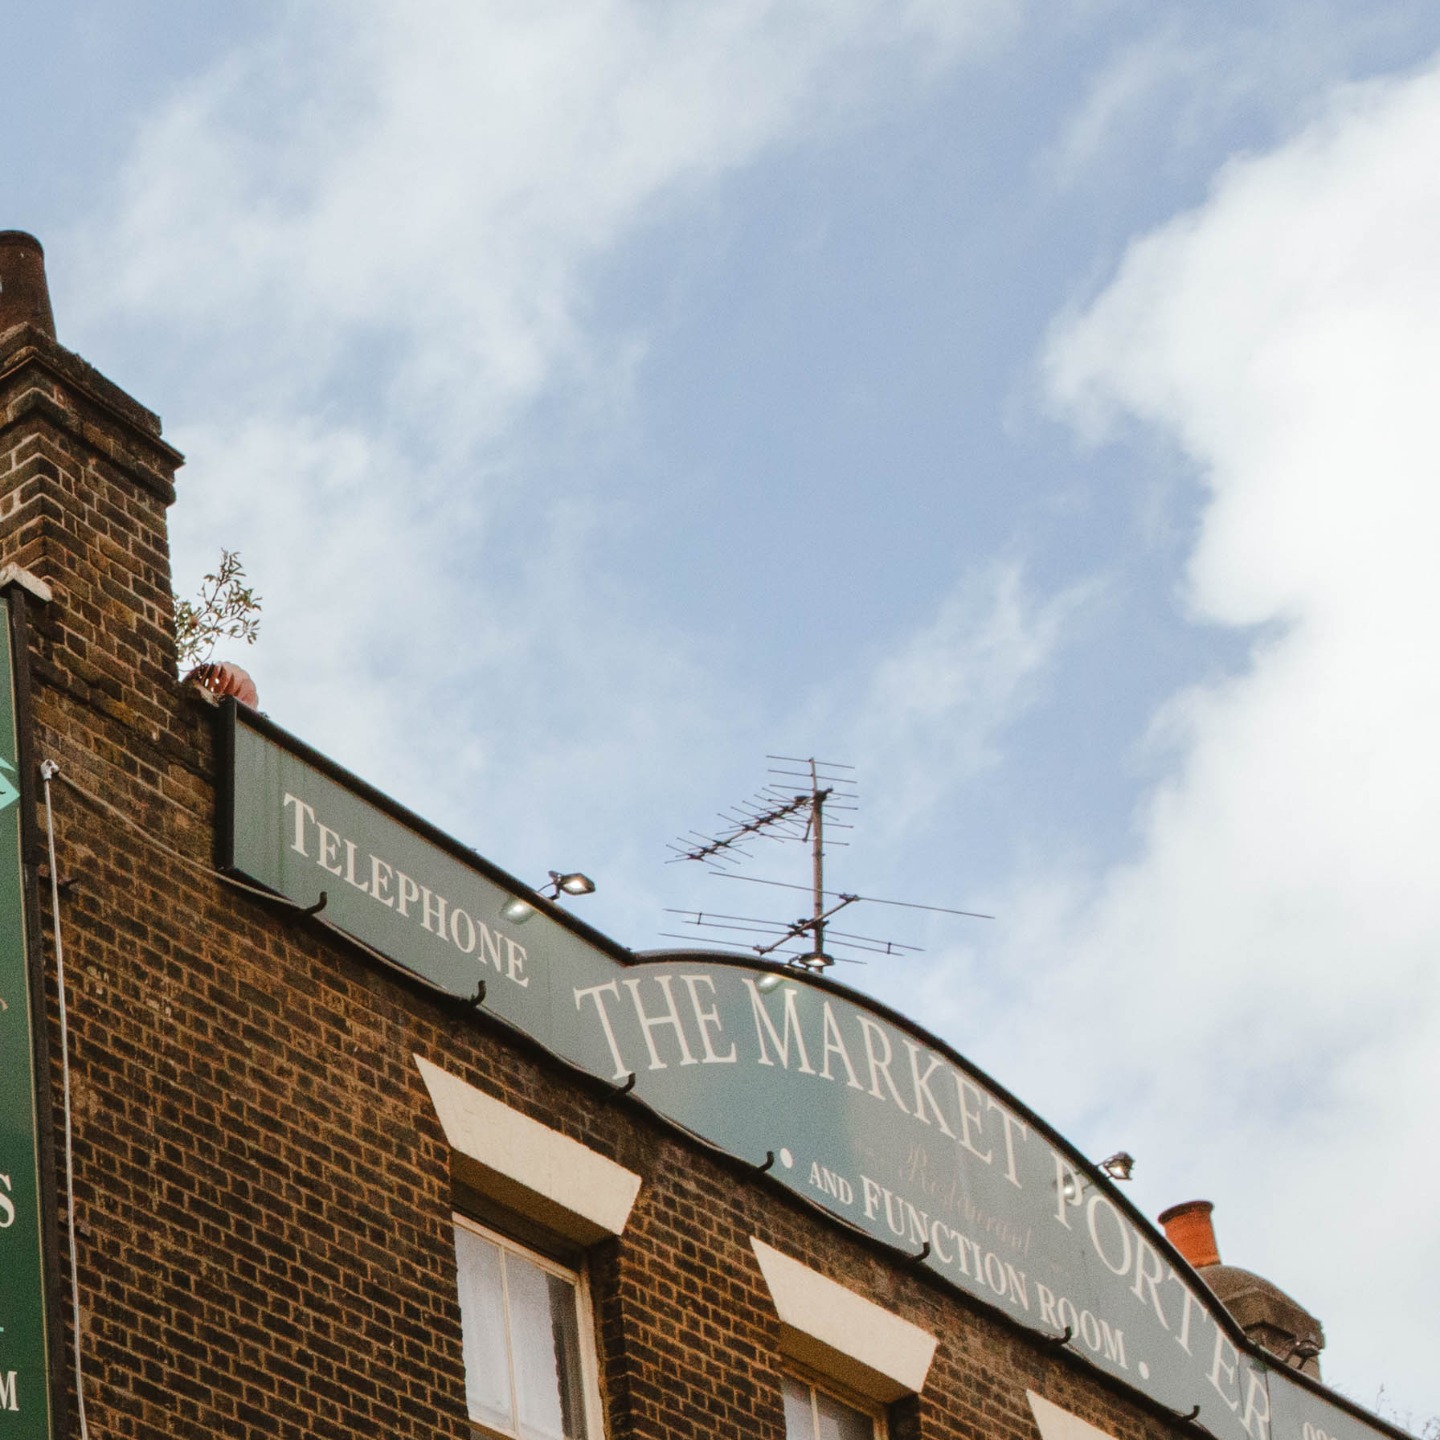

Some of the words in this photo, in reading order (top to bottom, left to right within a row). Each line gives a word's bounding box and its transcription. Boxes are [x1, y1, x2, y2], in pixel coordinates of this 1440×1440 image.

[283, 792, 528, 988] TELEPHONE
[573, 974, 737, 1080] THE
[741, 976, 1027, 1189] MARKET
[808, 1160, 854, 1206] AND
[860, 1172, 1028, 1311] FUNCTION
[1035, 1280, 1128, 1372] ROOM
